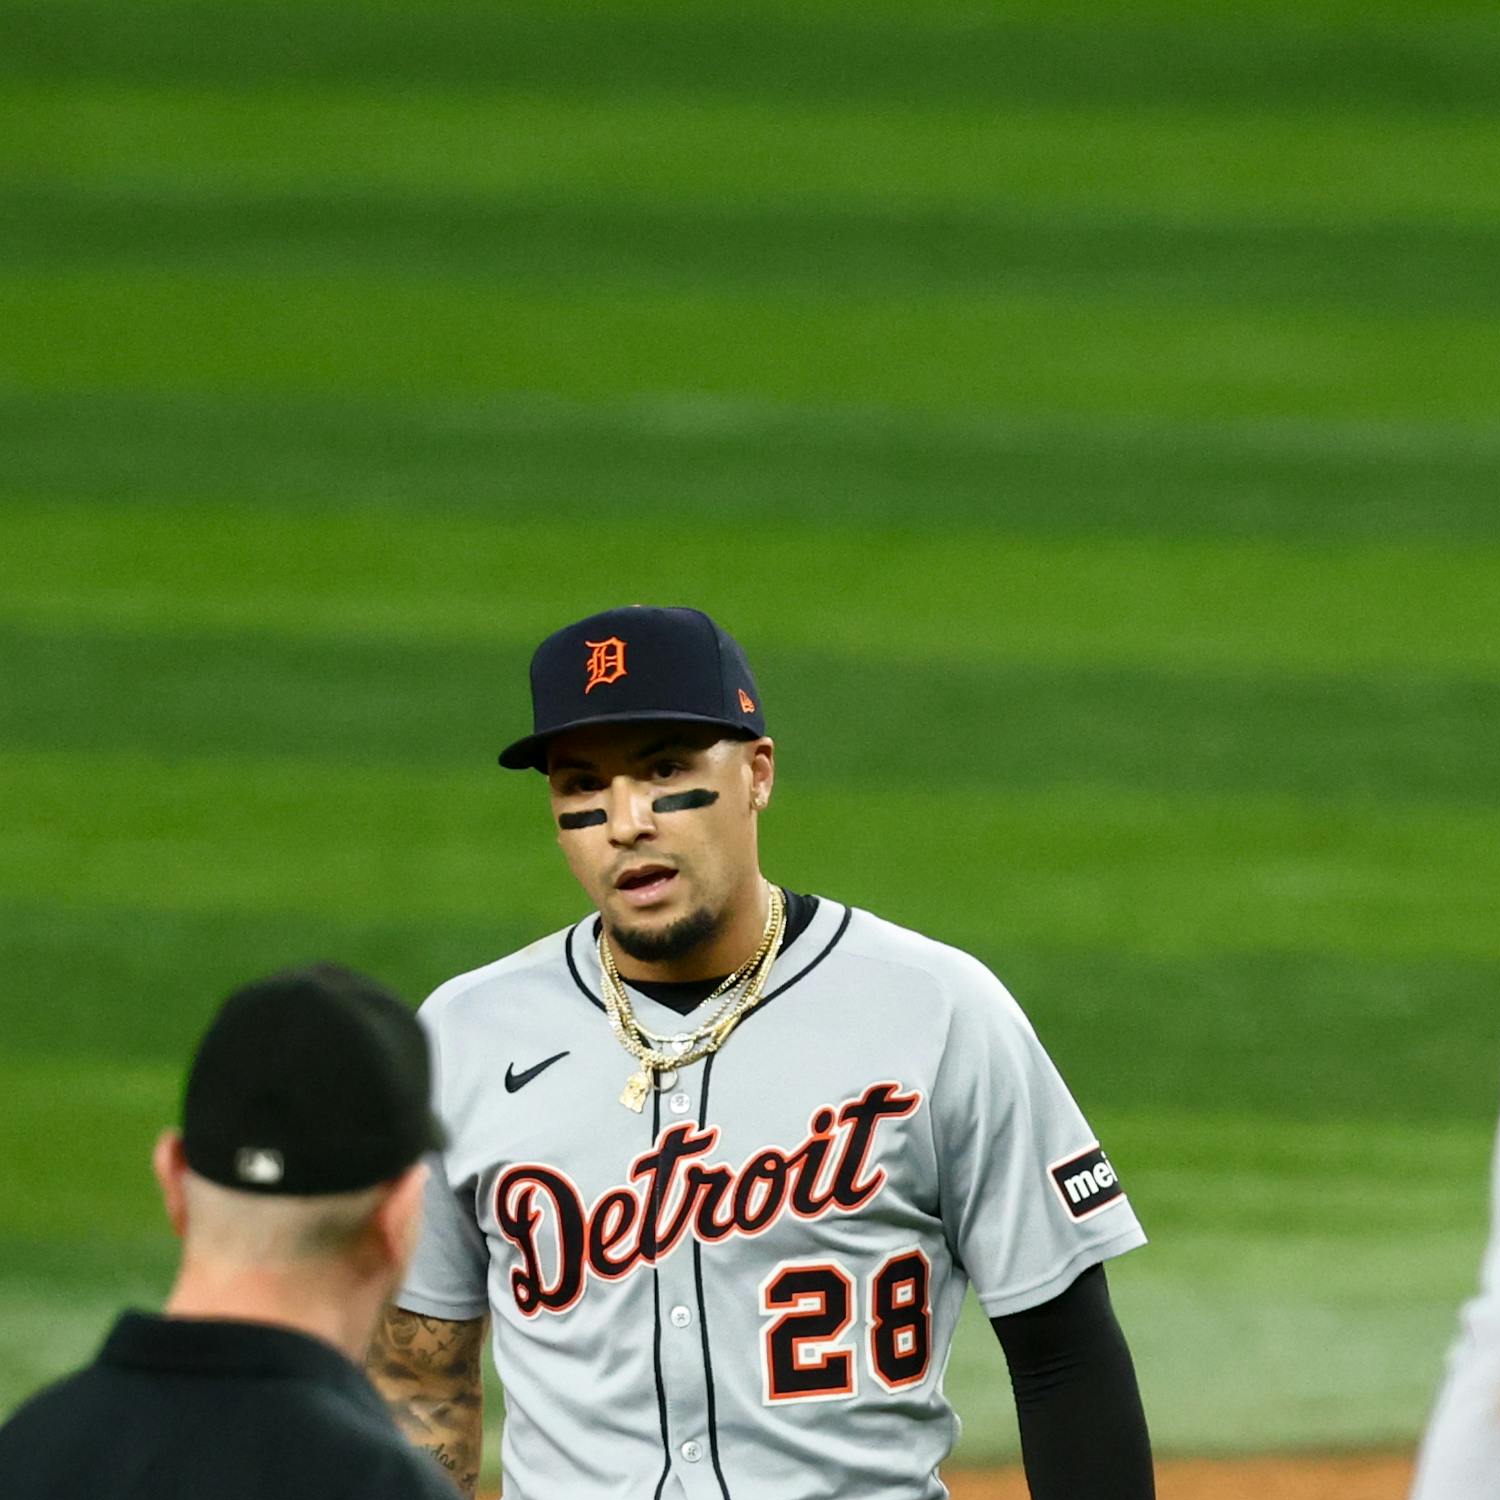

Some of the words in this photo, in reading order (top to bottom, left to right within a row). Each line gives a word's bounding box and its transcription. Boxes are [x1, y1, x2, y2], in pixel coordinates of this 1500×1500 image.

[585, 637, 627, 694] D
[494, 1081, 924, 1320] Detroit
[757, 1244, 932, 1406] 28
